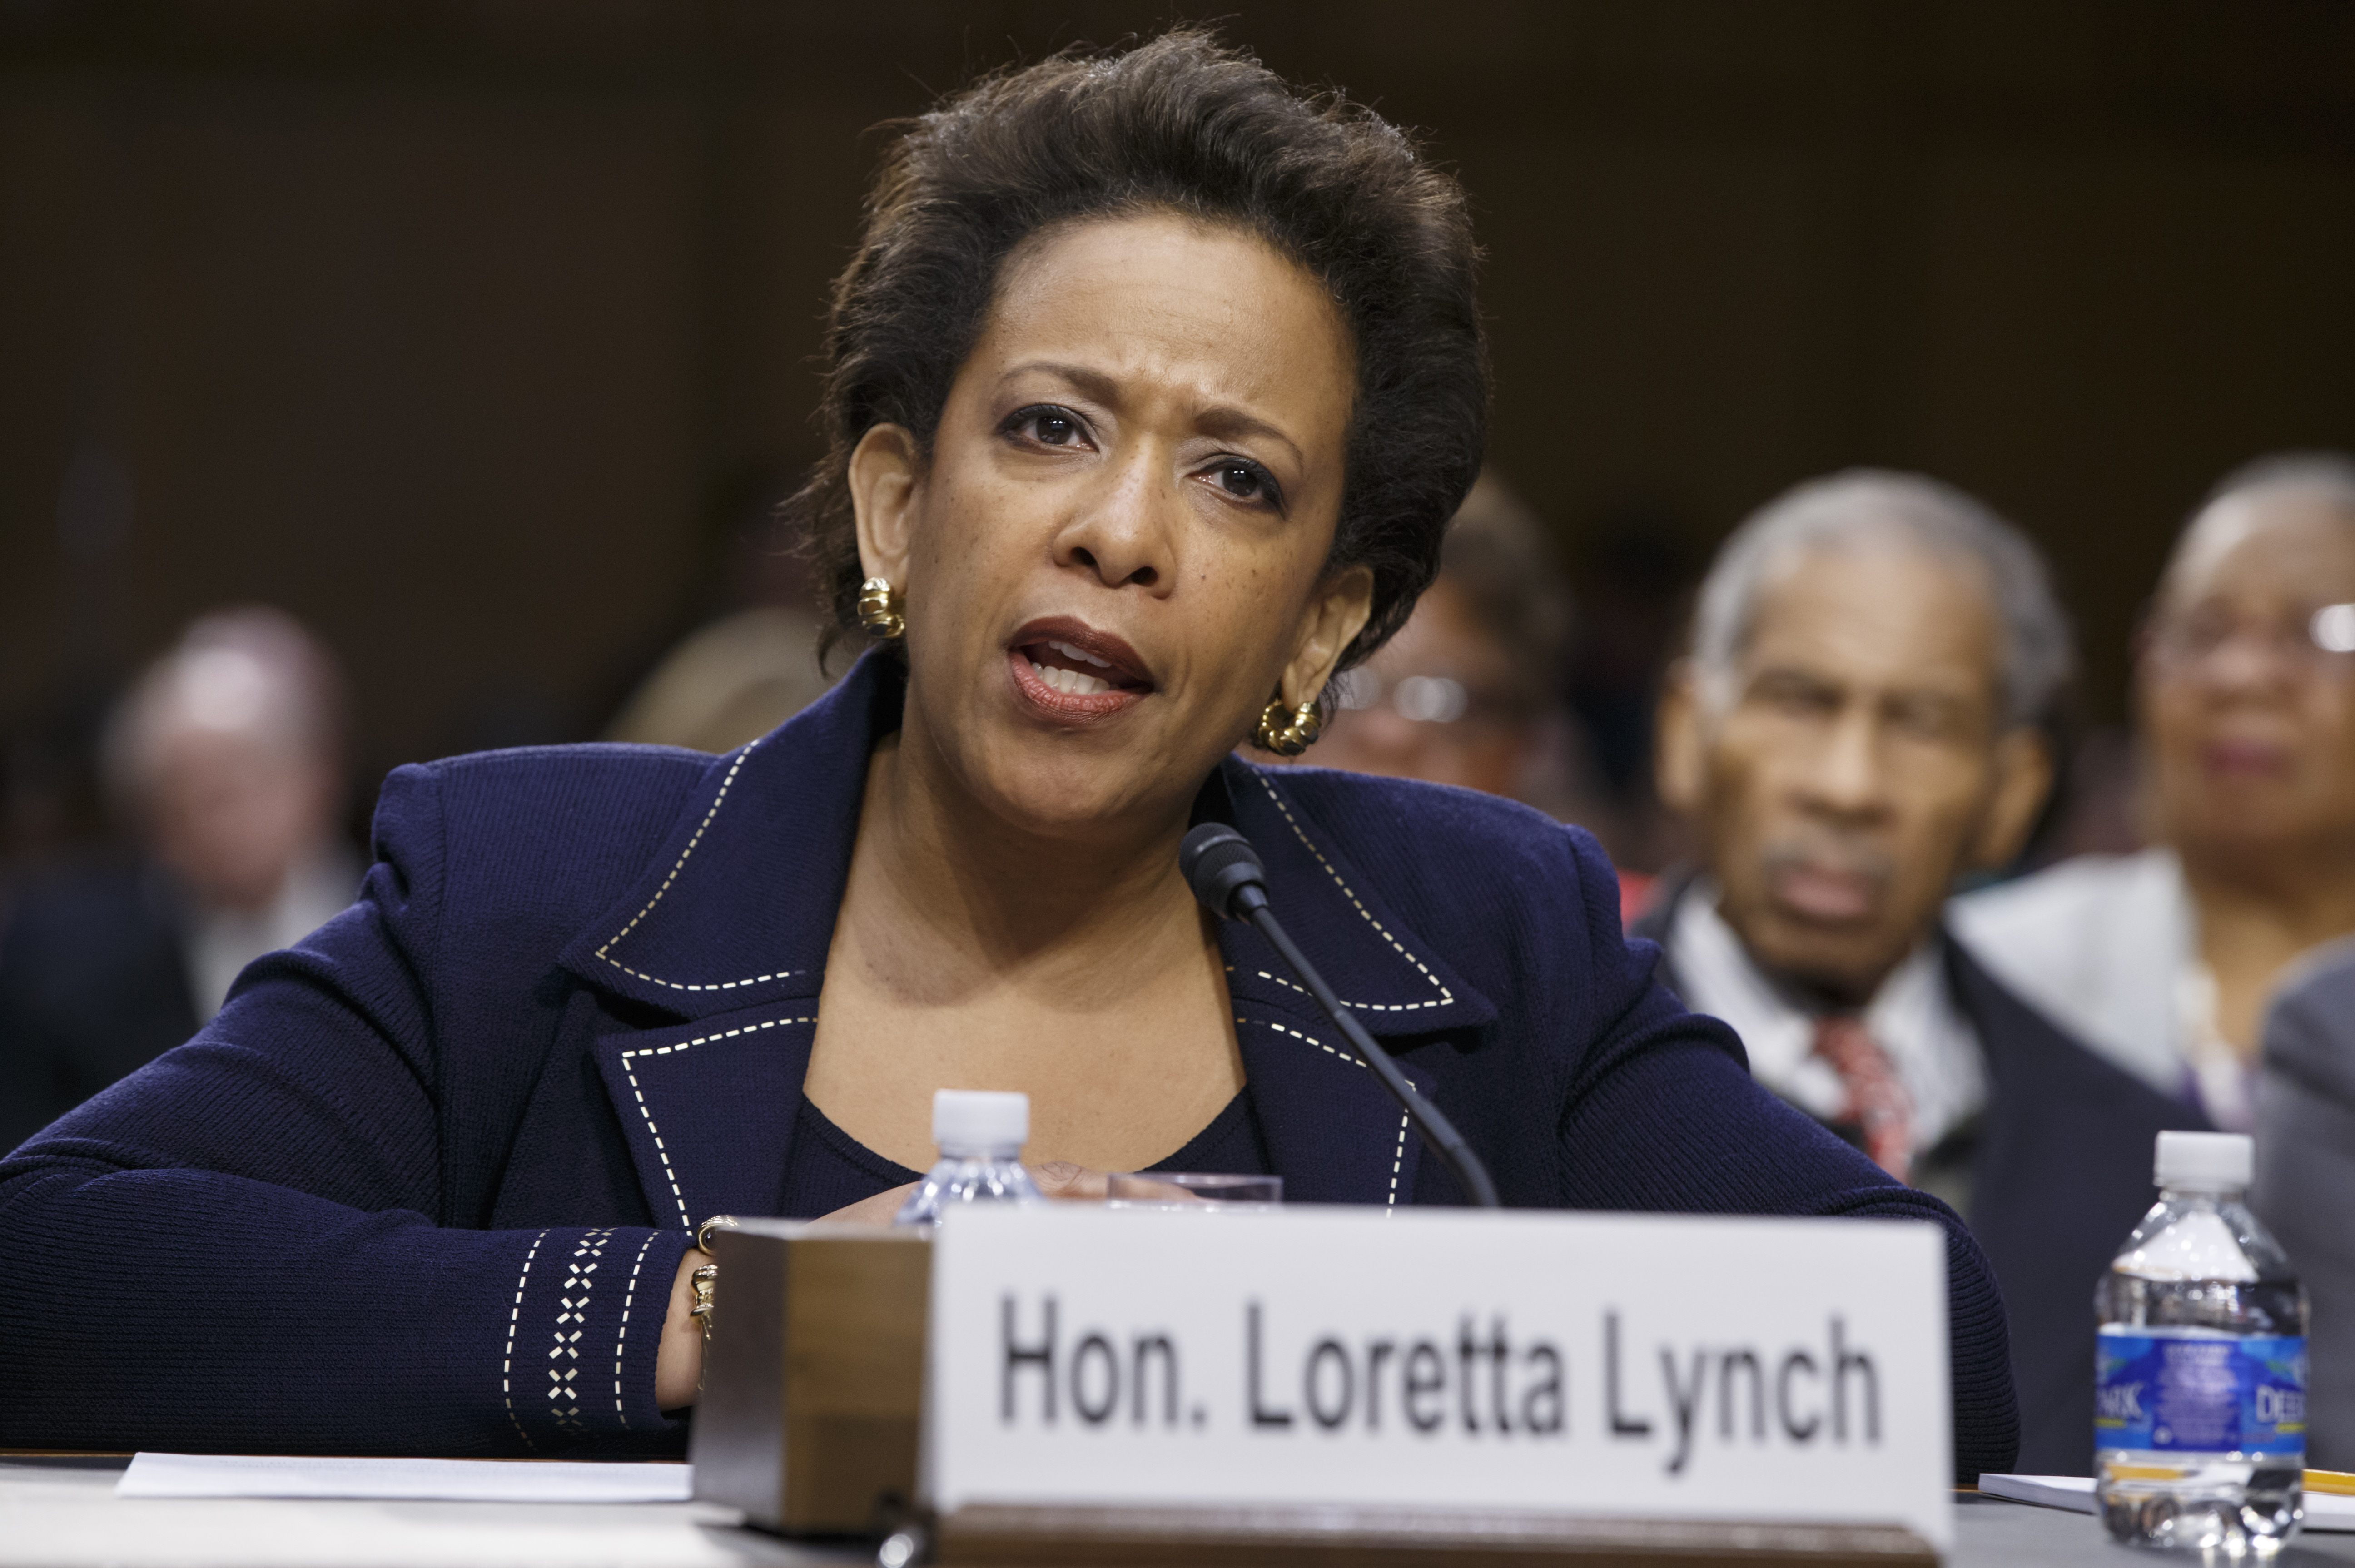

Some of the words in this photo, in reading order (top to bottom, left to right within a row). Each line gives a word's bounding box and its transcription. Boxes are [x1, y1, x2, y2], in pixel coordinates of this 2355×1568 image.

[999, 1295, 1207, 1430] Hon.
[1245, 1301, 1568, 1440] Loretta
[1603, 1311, 1883, 1479] Lynch
